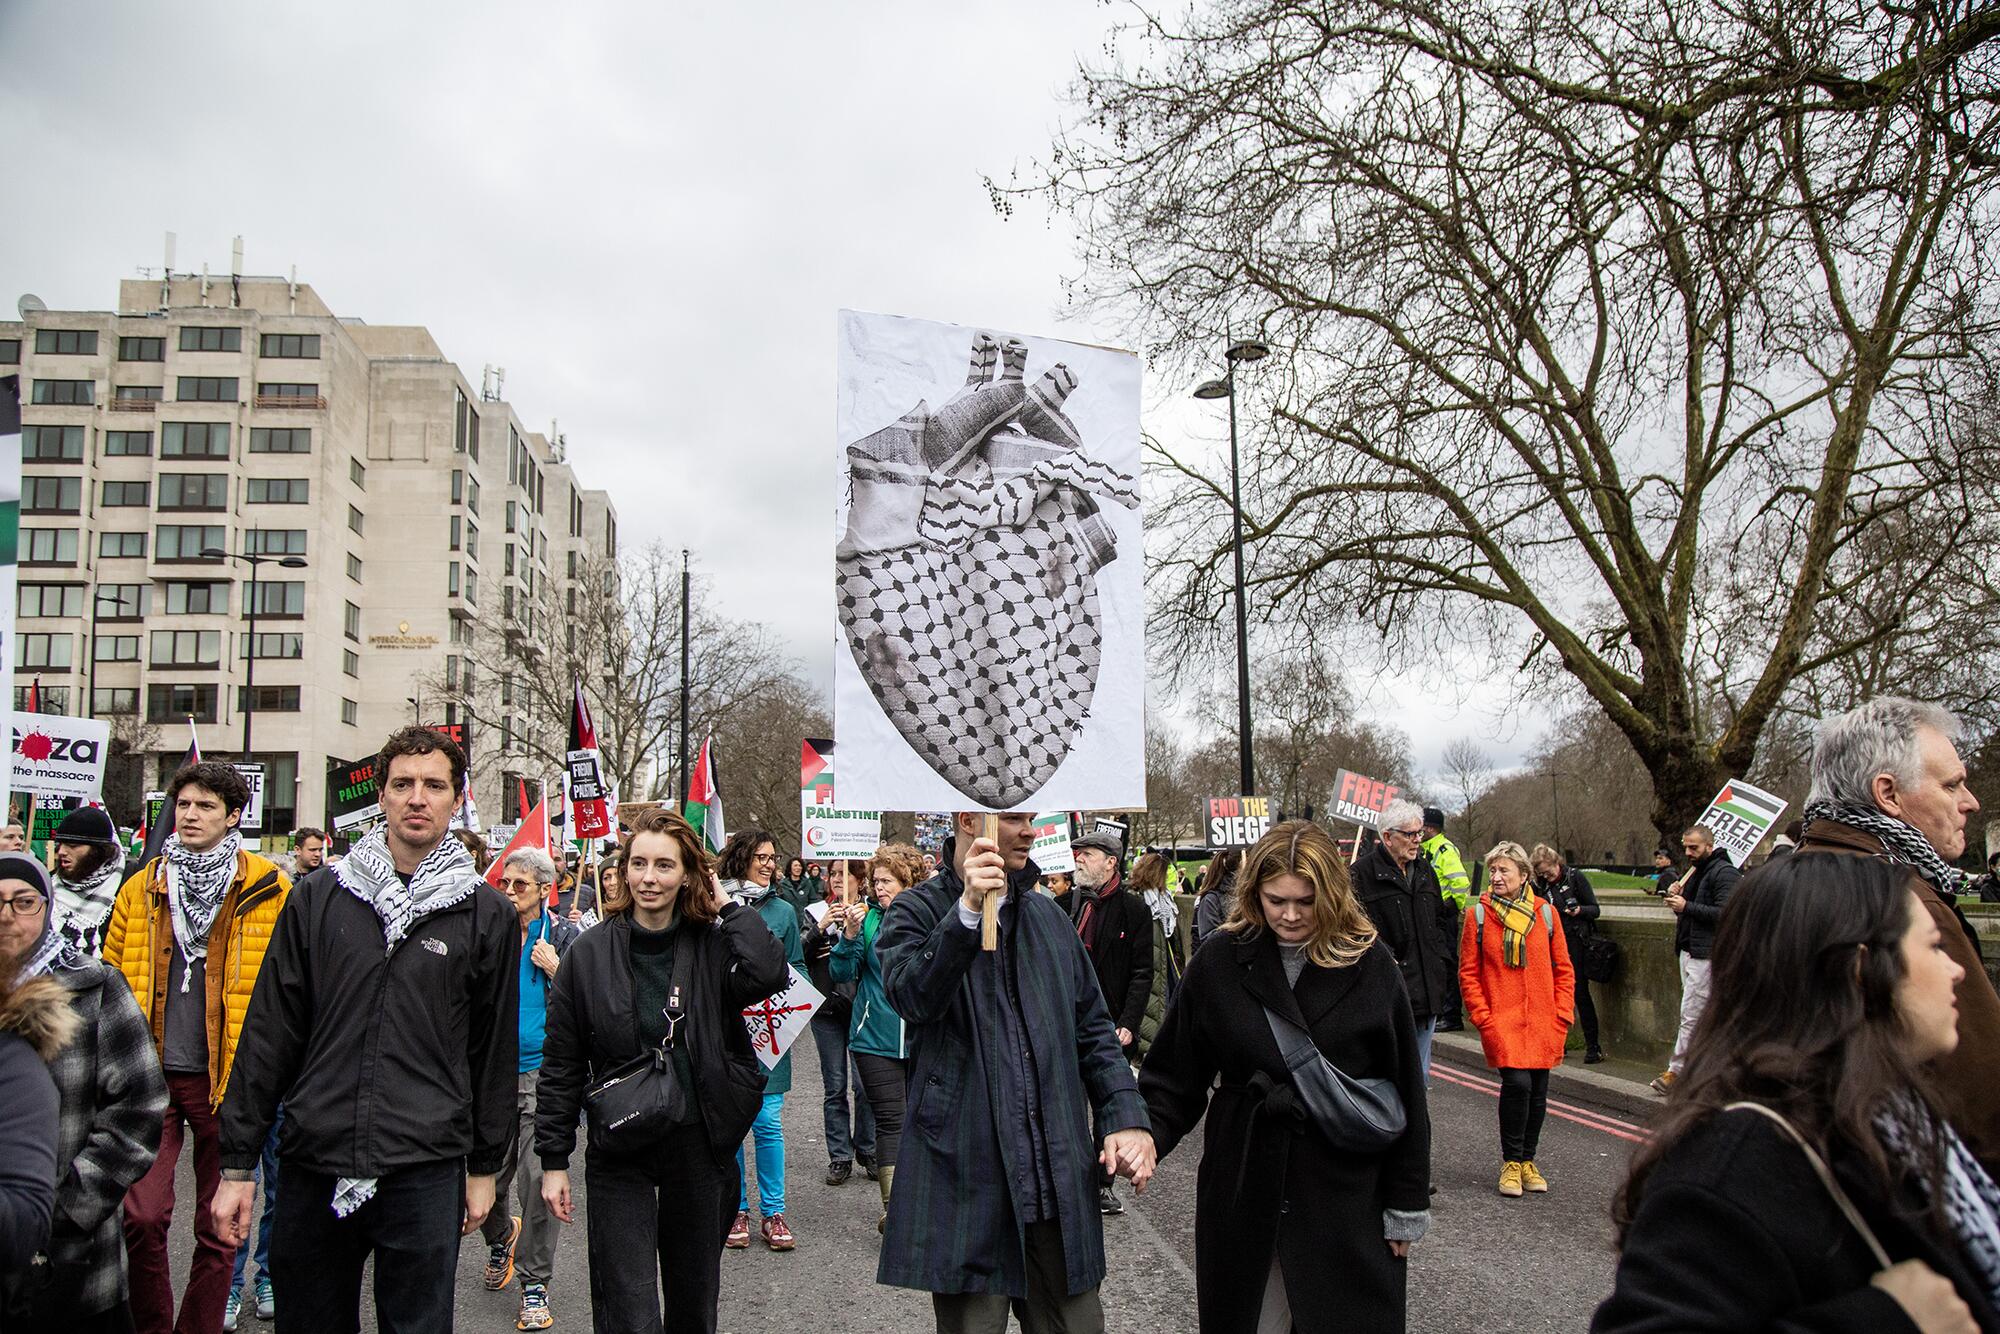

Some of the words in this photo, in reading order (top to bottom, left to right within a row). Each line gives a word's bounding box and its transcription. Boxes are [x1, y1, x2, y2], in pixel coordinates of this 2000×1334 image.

[13, 766, 32, 776] the
[36, 769, 96, 782] massacre
[350, 764, 374, 784] FREE
[338, 778, 375, 802] PALEST
[1339, 771, 1398, 813] FREE
[48, 800, 63, 809] SEA
[806, 806, 878, 820] PALESTINE
[1210, 798, 1239, 817] END
[1242, 798, 1269, 816] THE
[1336, 800, 1379, 825] PALESTI
[1211, 816, 1270, 845] SIEGE
[1701, 807, 1763, 845] FREE
